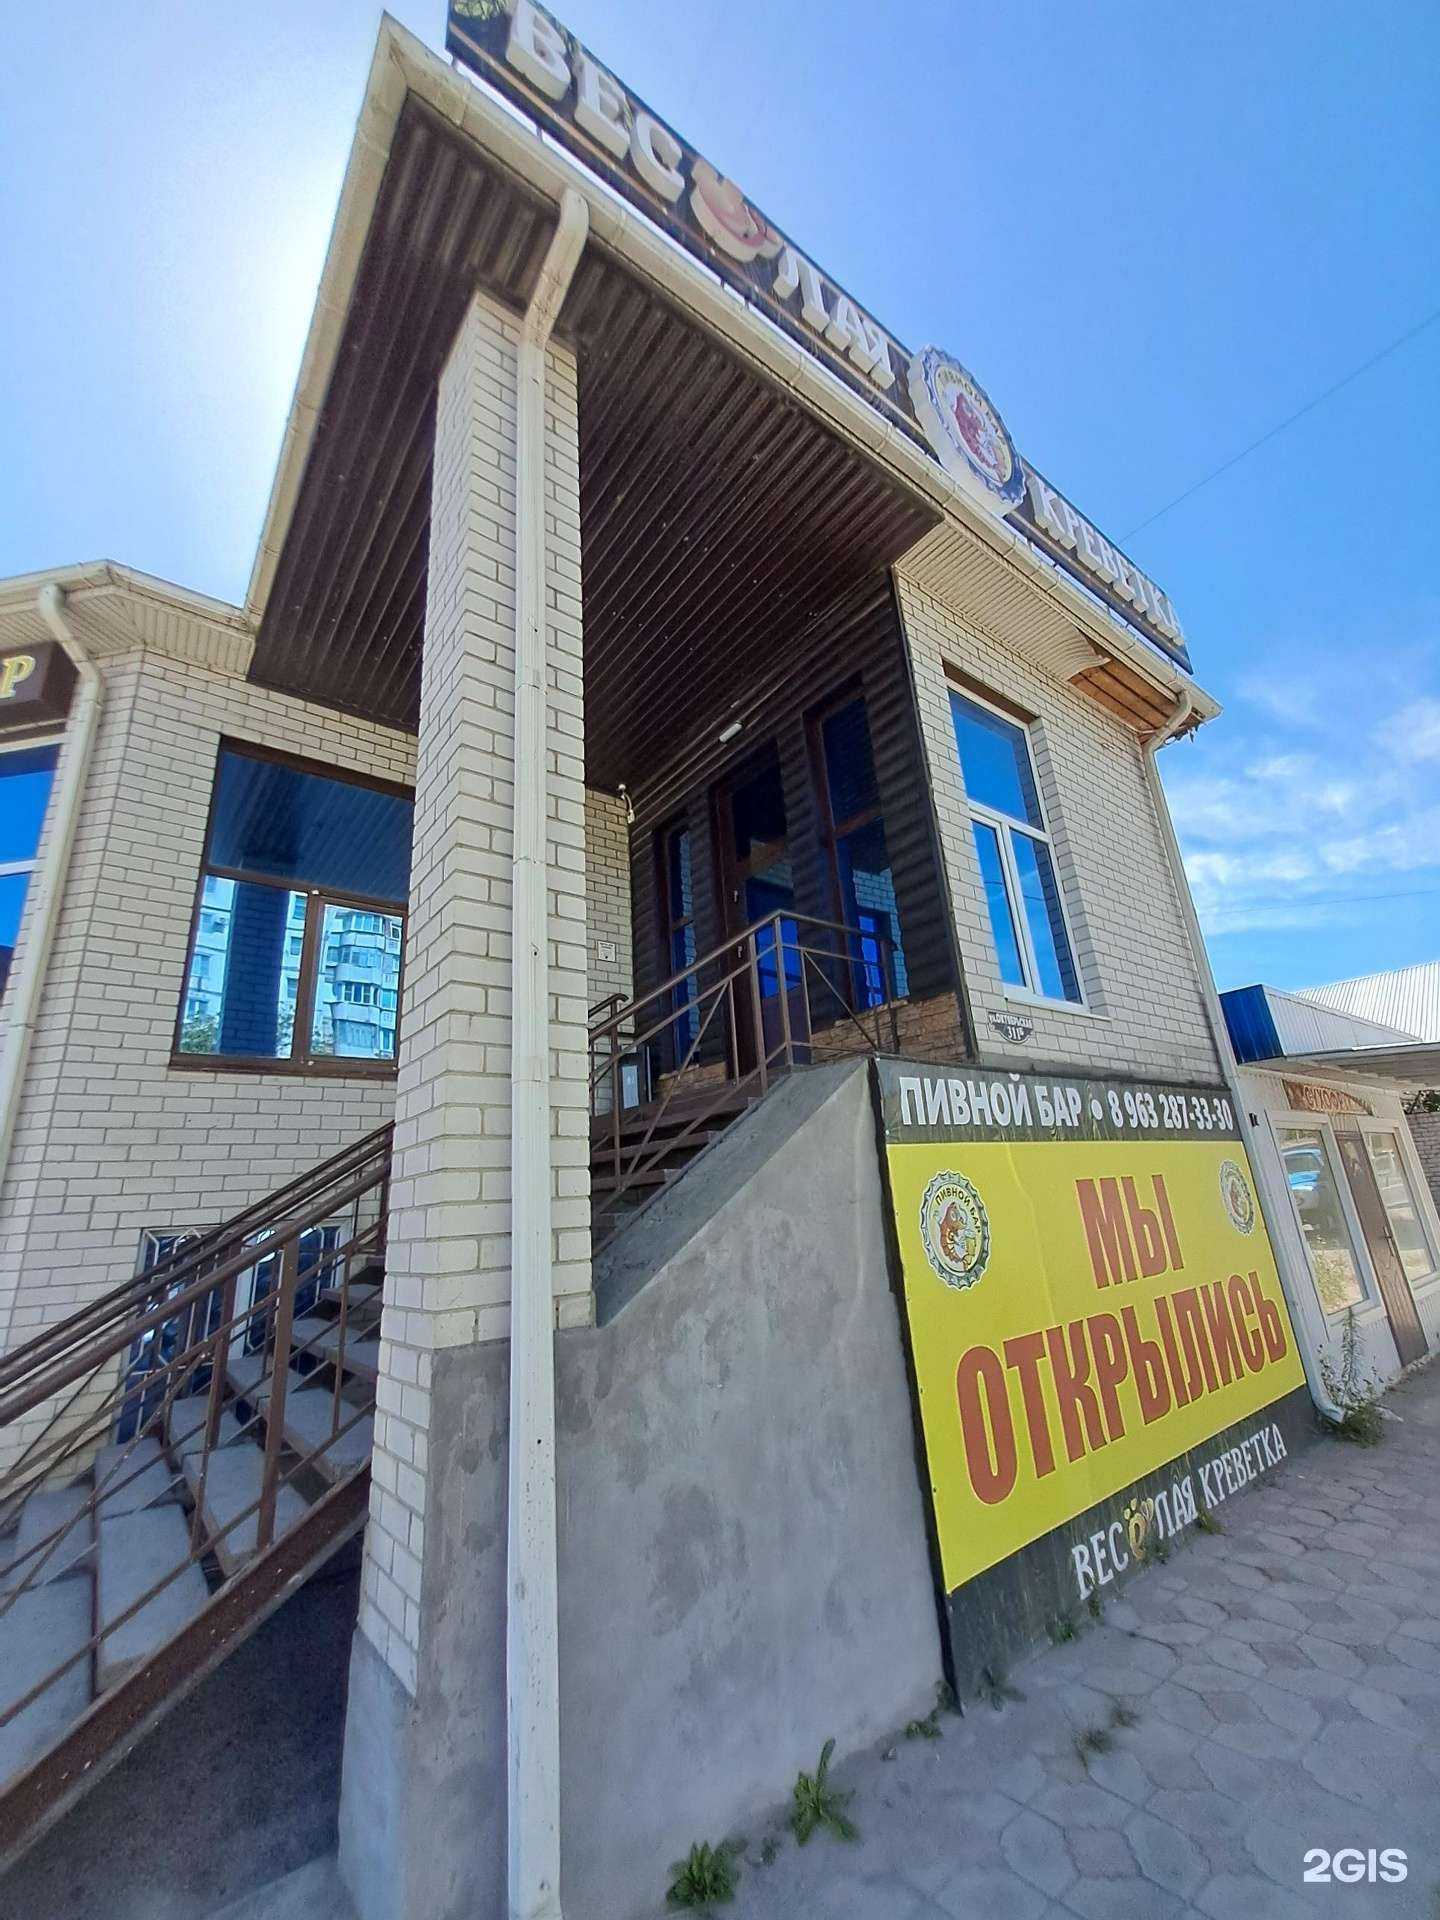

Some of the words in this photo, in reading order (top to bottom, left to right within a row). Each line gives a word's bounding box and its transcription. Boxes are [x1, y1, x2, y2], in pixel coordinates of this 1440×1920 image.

[1027, 474, 1185, 646] КРЕВЕТКА
[899, 1073, 1033, 1126] ПИВНОЙ
[1033, 1085, 1081, 1127] БАР
[1108, 1090, 1124, 1128] 8
[1128, 1093, 1158, 1128] 963
[1159, 1094, 1234, 1131] 287-33-30
[1076, 1174, 1184, 1290] МЫ
[956, 1271, 1289, 1505] ОТКРЫЛИСЬ
[1198, 1423, 1288, 1509] КРЕВЕТКА
